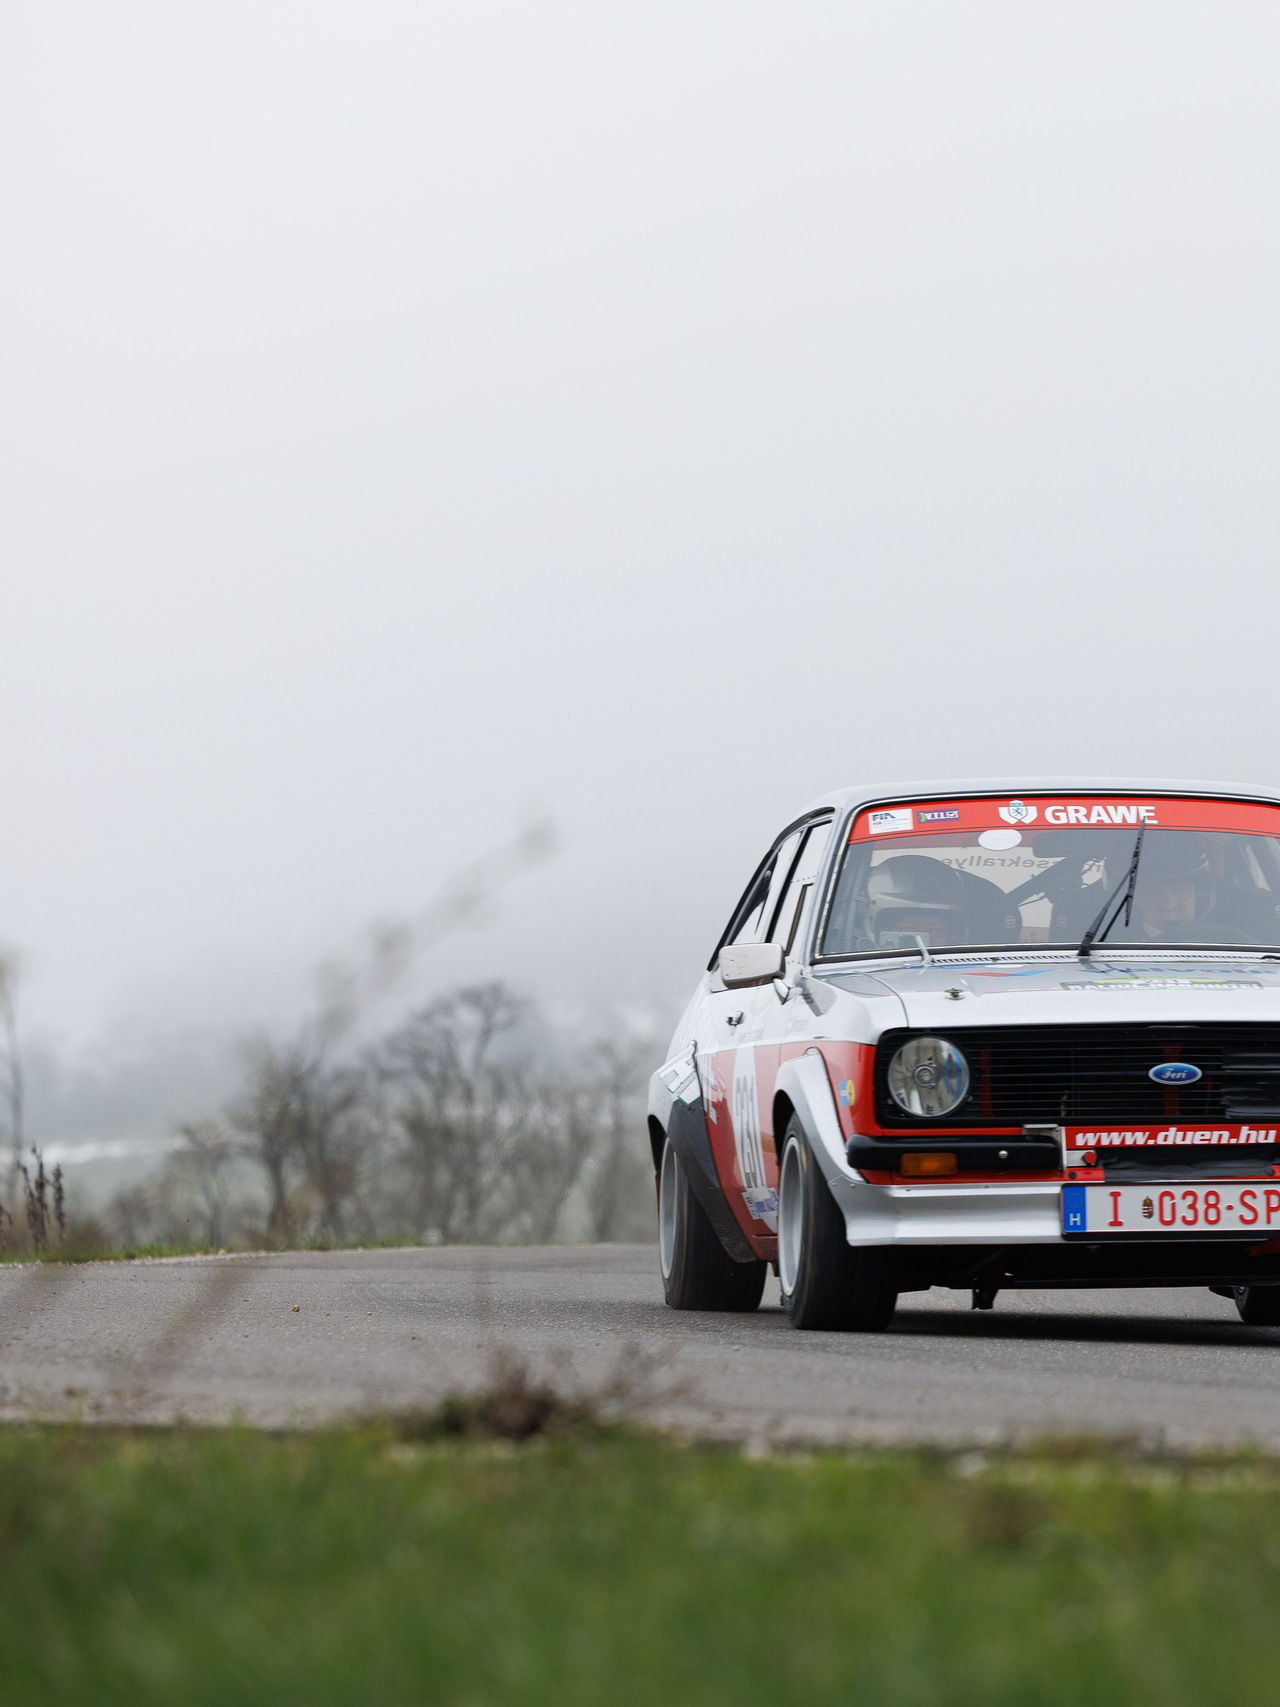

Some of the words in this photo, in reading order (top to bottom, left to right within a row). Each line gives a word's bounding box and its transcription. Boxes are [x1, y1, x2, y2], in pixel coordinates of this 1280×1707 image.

[1045, 805, 1159, 824] GRAWE
[1075, 1126, 1278, 1146] www.duen.hu
[1069, 1213, 1082, 1226] H
